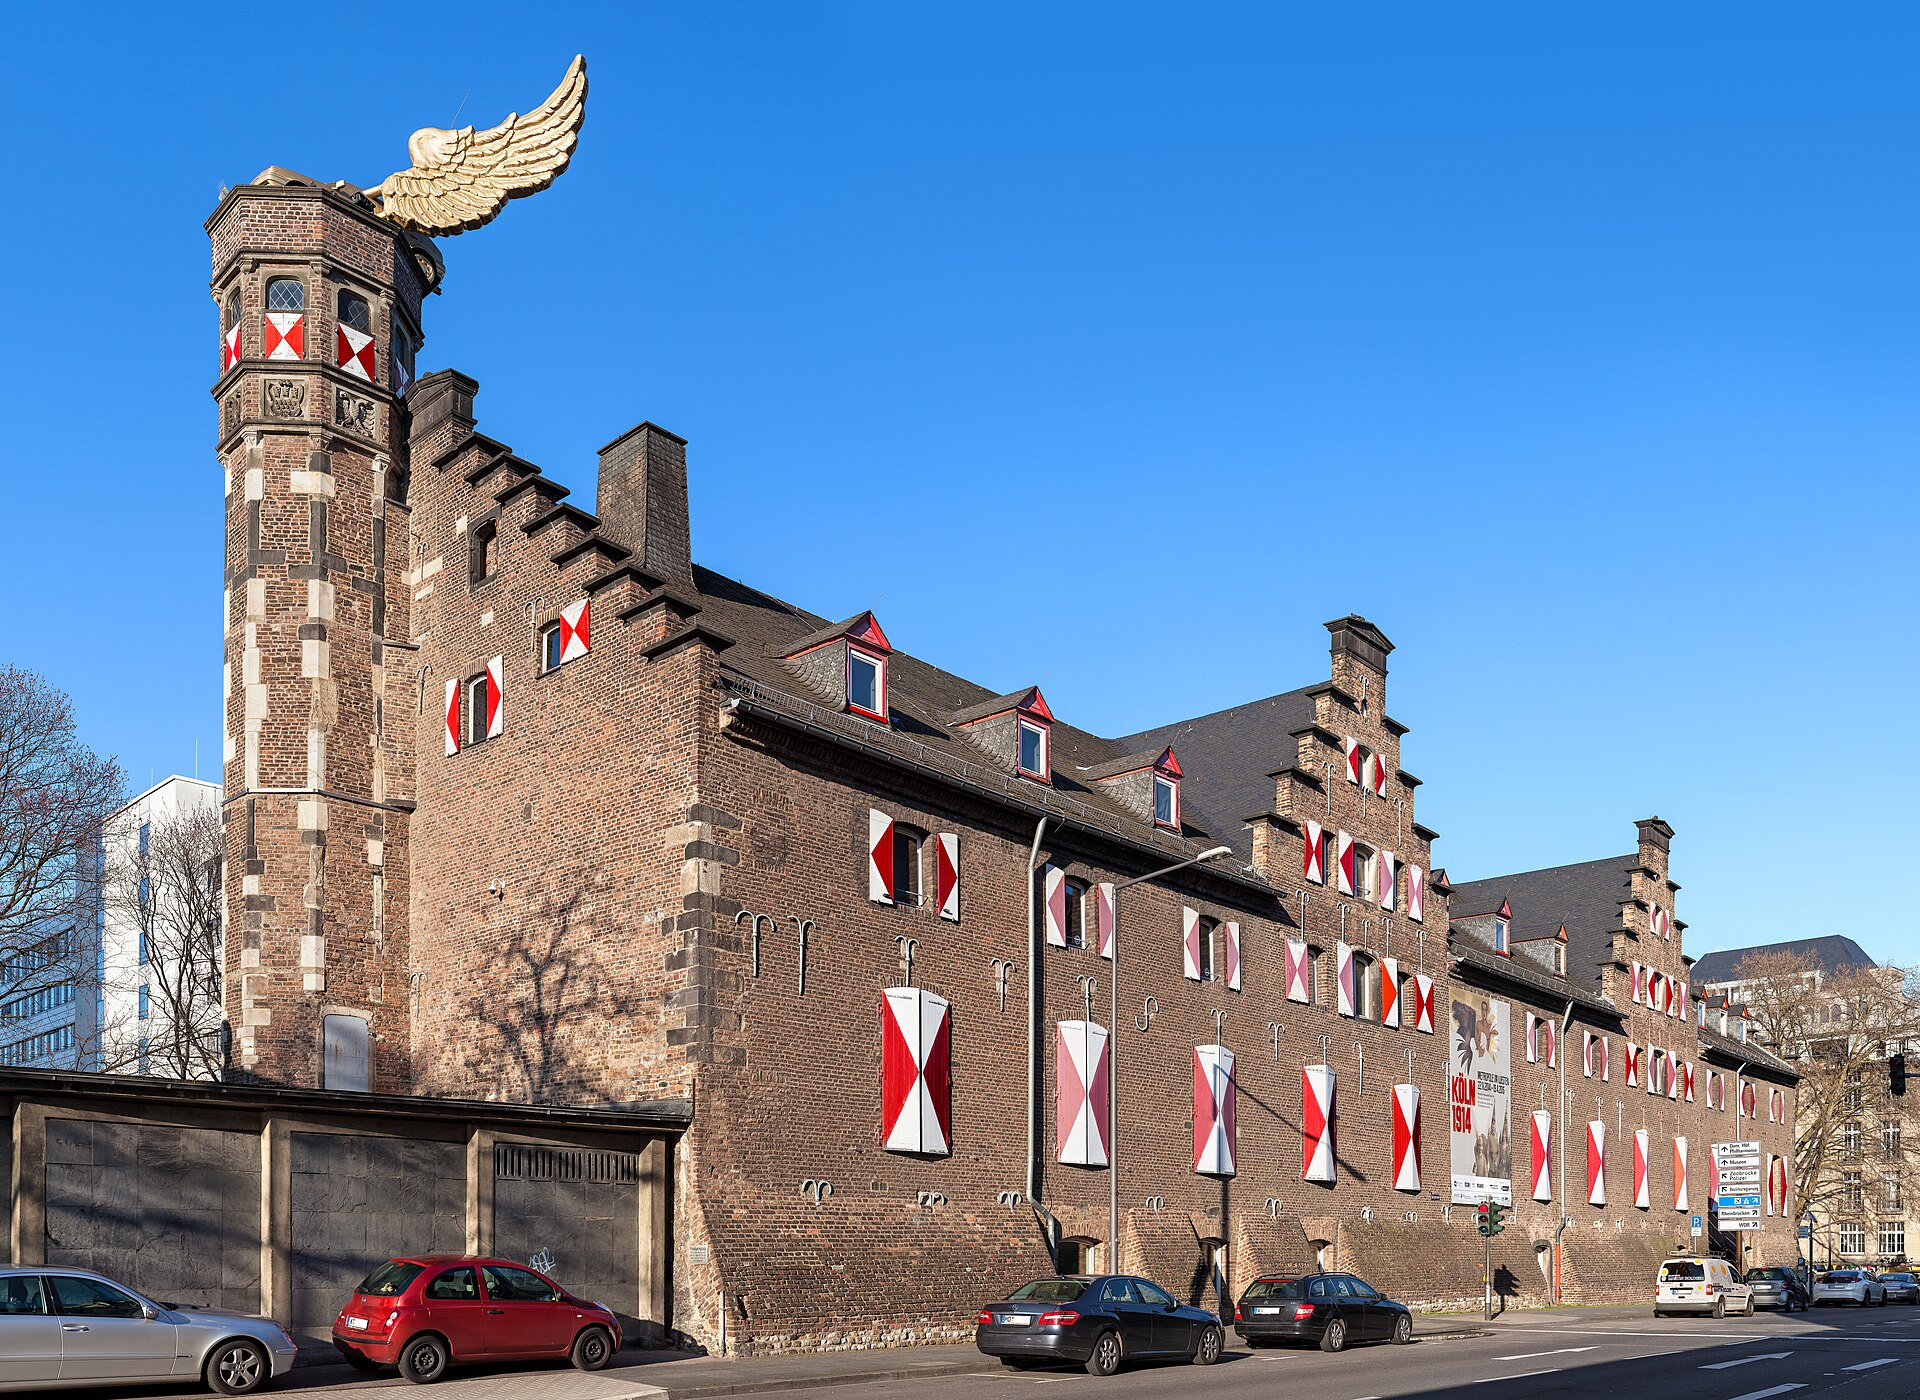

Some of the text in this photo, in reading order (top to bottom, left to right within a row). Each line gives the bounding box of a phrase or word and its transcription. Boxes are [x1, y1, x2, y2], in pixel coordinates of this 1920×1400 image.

[1451, 1071, 1476, 1106] KÖLN
[1451, 1104, 1472, 1134] 1914
[1693, 1217, 1700, 1227] P
